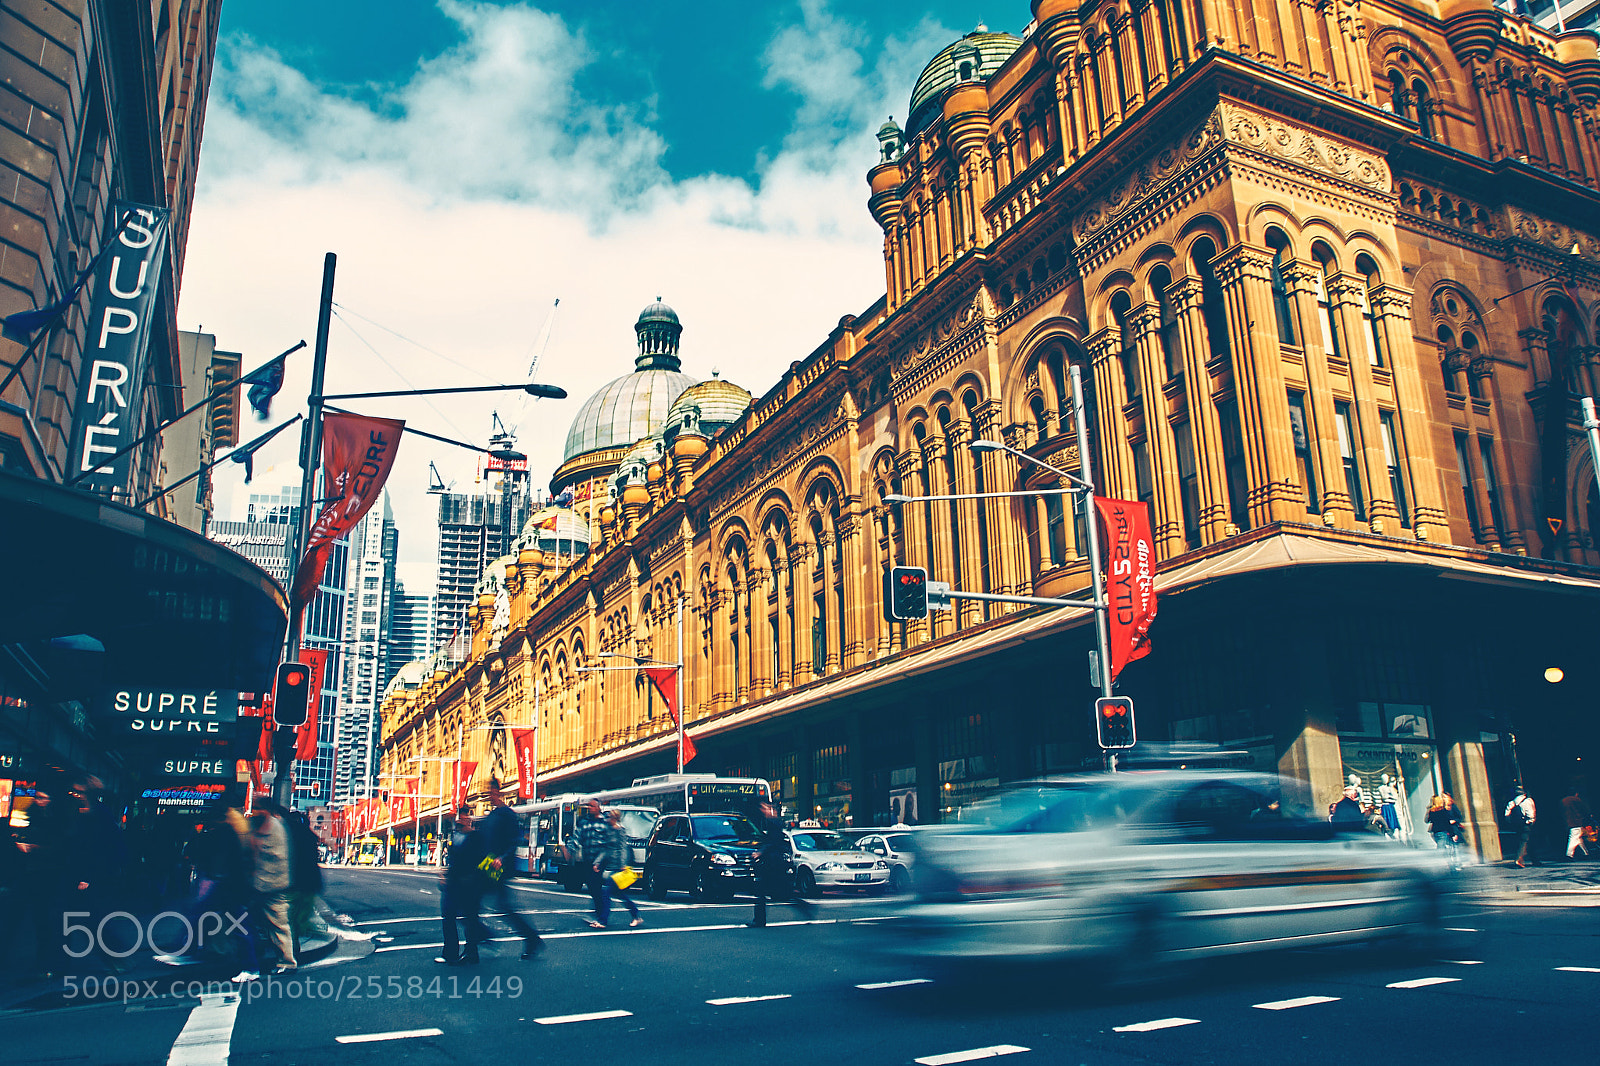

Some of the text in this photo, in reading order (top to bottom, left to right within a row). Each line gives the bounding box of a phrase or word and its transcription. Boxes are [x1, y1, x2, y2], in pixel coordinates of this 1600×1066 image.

[81, 207, 155, 474] SUPRÉ
[114, 690, 218, 715] SUPRÉ
[164, 759, 223, 774] SUPRÉ
[700, 785, 716, 794] CITY
[739, 785, 754, 794] 422
[158, 798, 204, 806] manhattan
